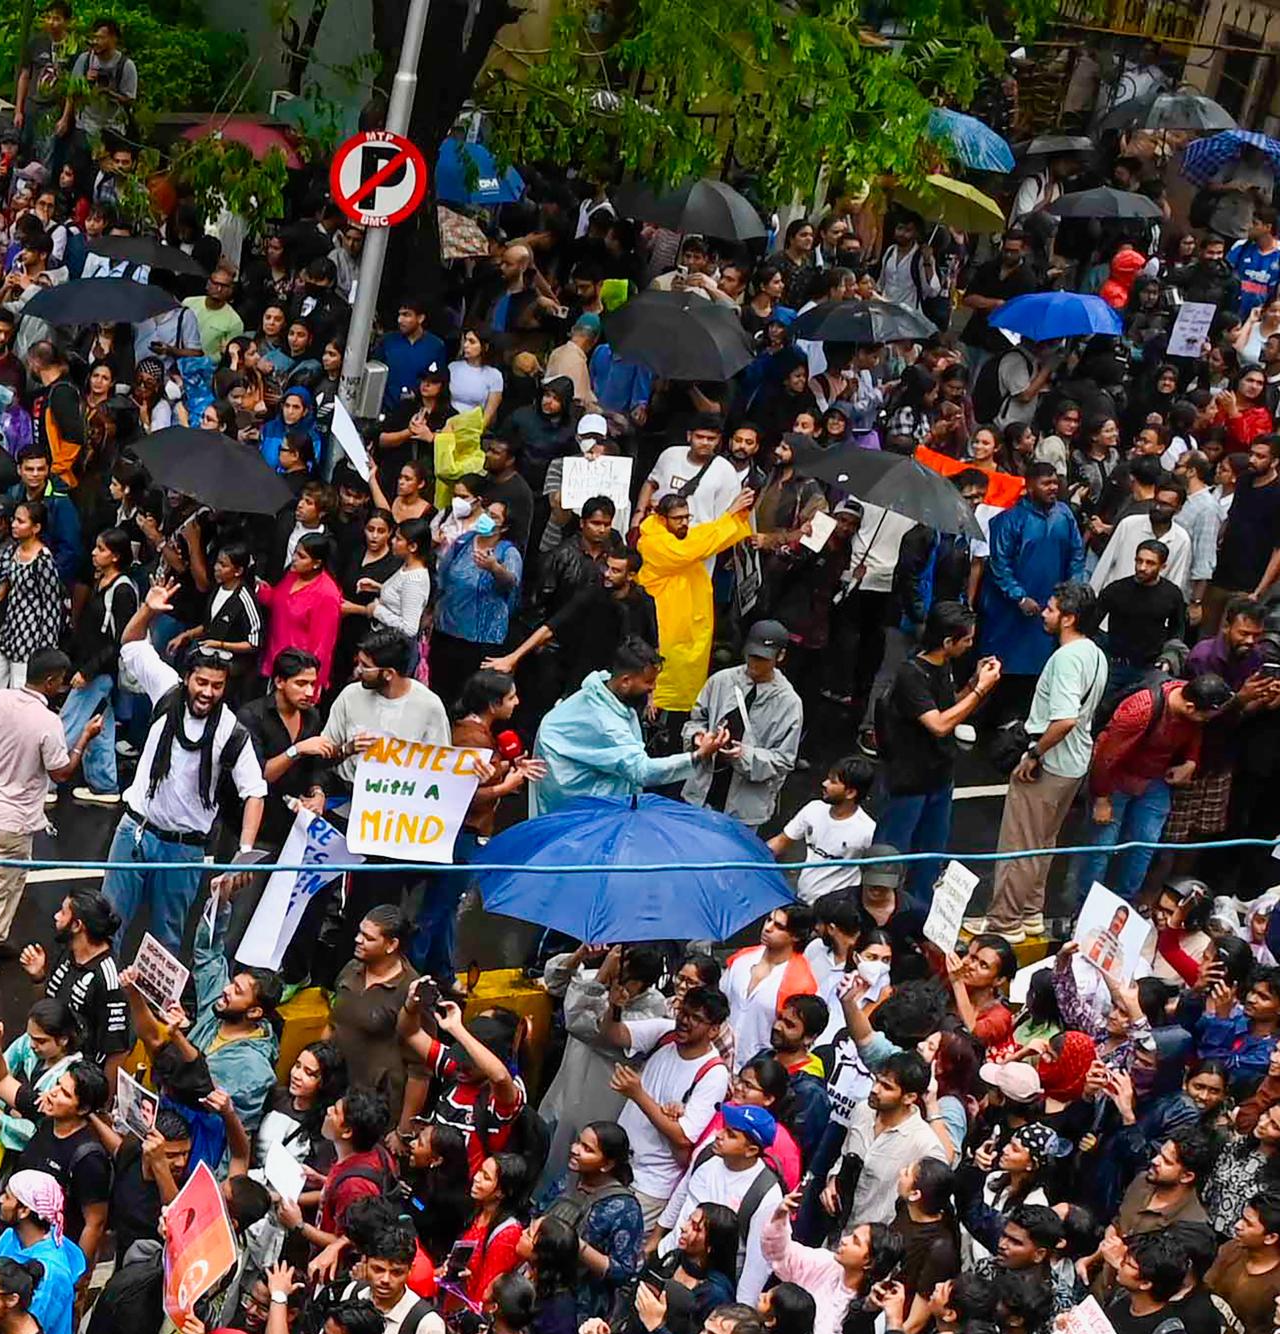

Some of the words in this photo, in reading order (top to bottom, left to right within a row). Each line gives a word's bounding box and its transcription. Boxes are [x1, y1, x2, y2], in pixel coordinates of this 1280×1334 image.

[365, 132, 394, 141] MTP
[363, 737, 480, 776] ARMED
[424, 784, 440, 801] A
